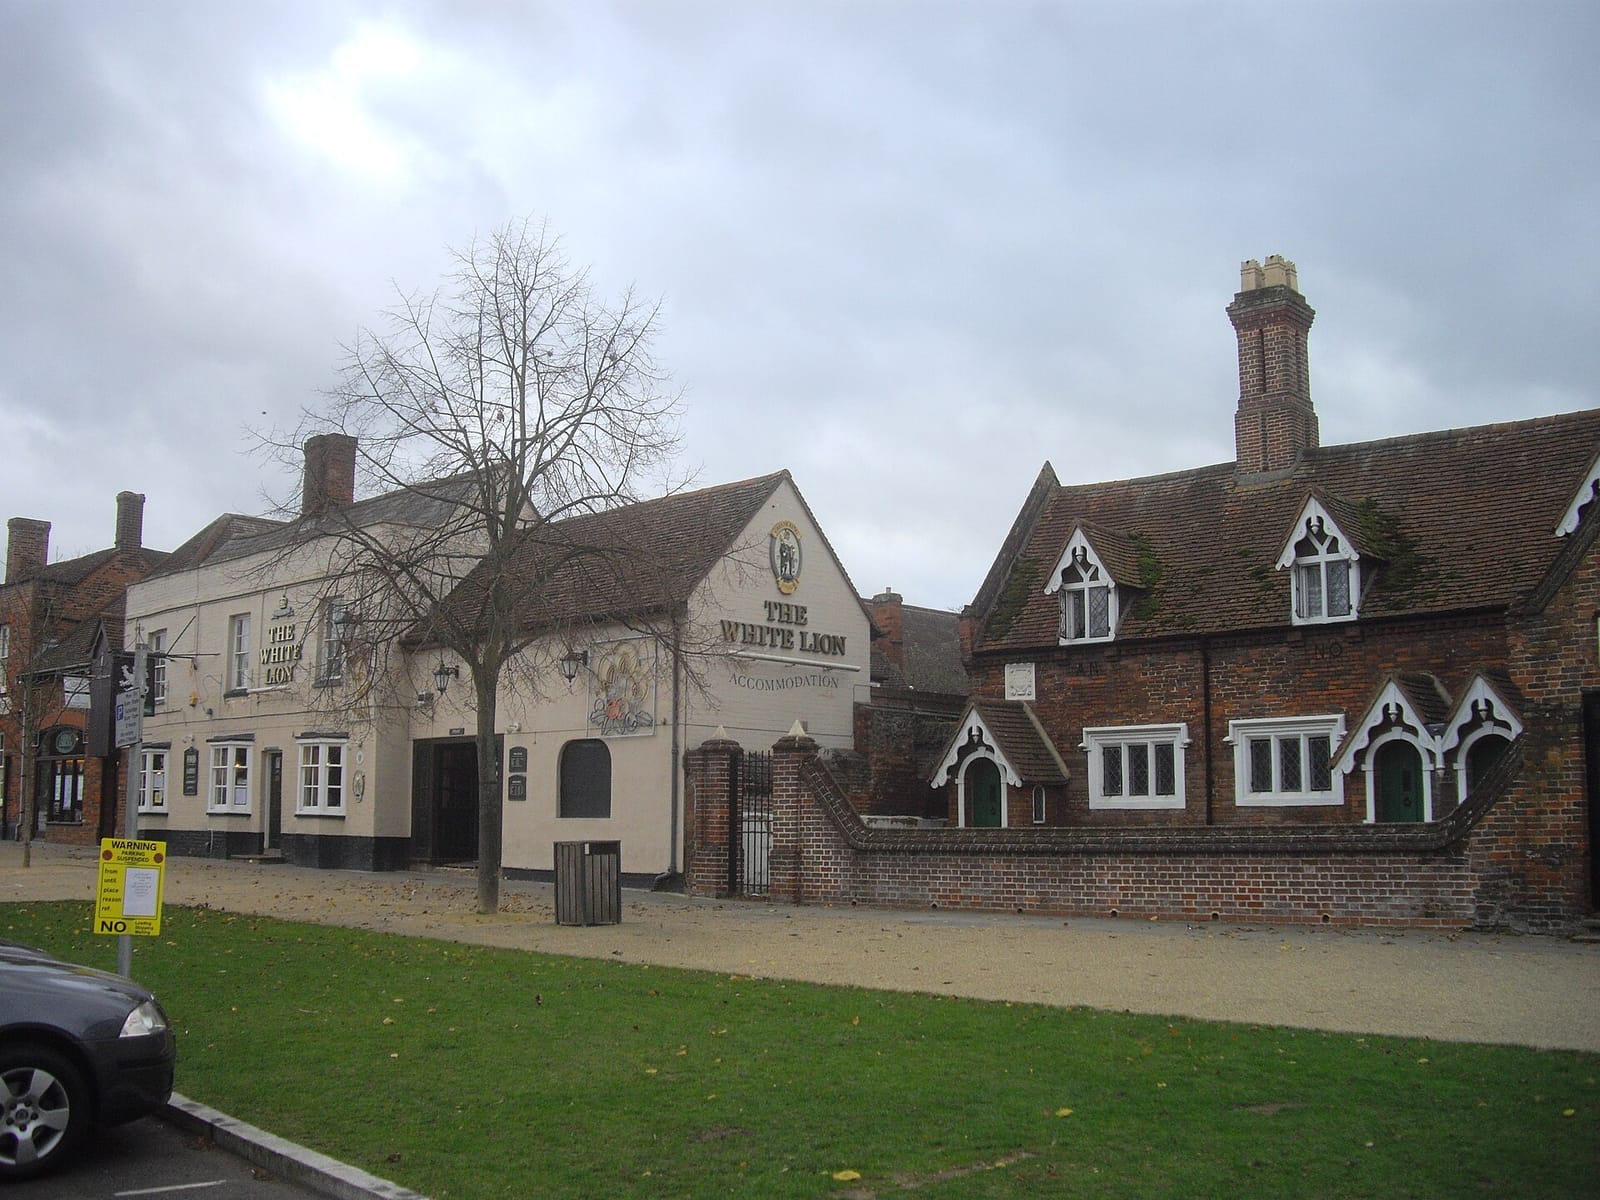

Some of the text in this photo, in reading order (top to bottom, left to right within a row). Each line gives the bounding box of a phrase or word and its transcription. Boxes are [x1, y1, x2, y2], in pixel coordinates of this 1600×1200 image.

[764, 600, 808, 625] THE
[269, 624, 295, 643] THE
[720, 619, 847, 656] WHITE LION
[260, 643, 302, 664] WHITE
[265, 666, 294, 684] LION
[728, 671, 840, 692] ACCOMMODATION
[112, 841, 156, 851] WARNING
[101, 921, 126, 932] NO
